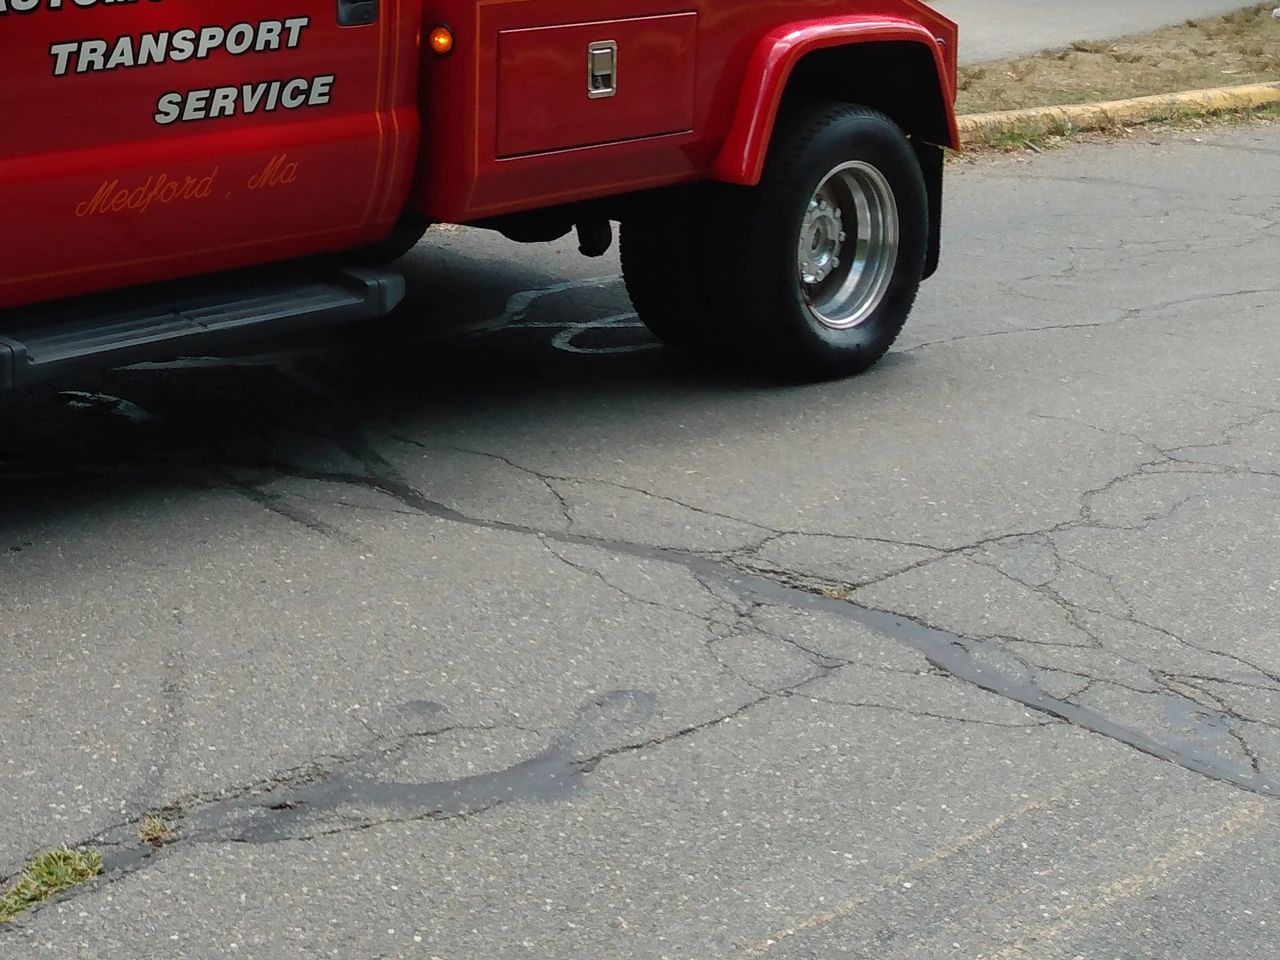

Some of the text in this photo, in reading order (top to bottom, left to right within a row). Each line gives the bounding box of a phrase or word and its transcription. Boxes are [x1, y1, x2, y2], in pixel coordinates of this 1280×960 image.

[49, 16, 310, 76] TRANSPORT
[153, 75, 336, 125] SERVICE
[247, 153, 299, 190] Ma
